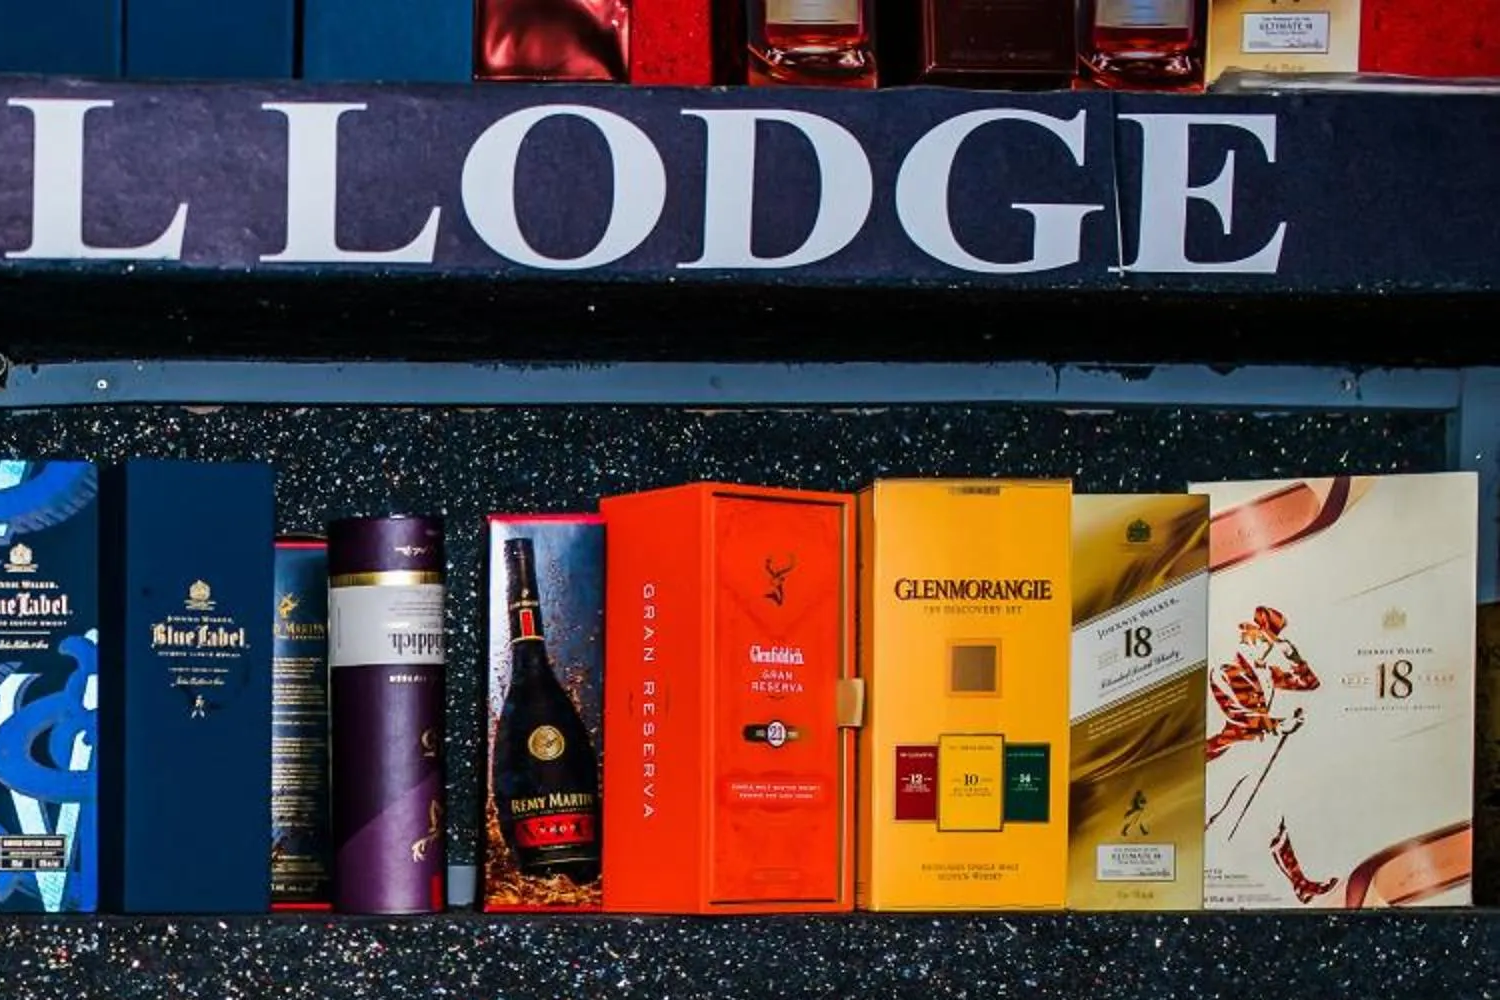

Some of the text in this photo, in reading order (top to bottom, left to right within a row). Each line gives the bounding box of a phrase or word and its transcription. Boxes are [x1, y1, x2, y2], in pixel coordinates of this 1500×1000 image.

[258, 102, 1288, 274] LODGE
[894, 577, 1053, 601] GLENMORANGIE
[16, 592, 68, 617] Label
[151, 624, 246, 649] Blue Label
[1123, 625, 1153, 659] 18
[1376, 659, 1414, 699] 18
[643, 583, 656, 818] GRAN RESERVA
[963, 773, 979, 786] 10
[549, 791, 593, 808] MARTIN
